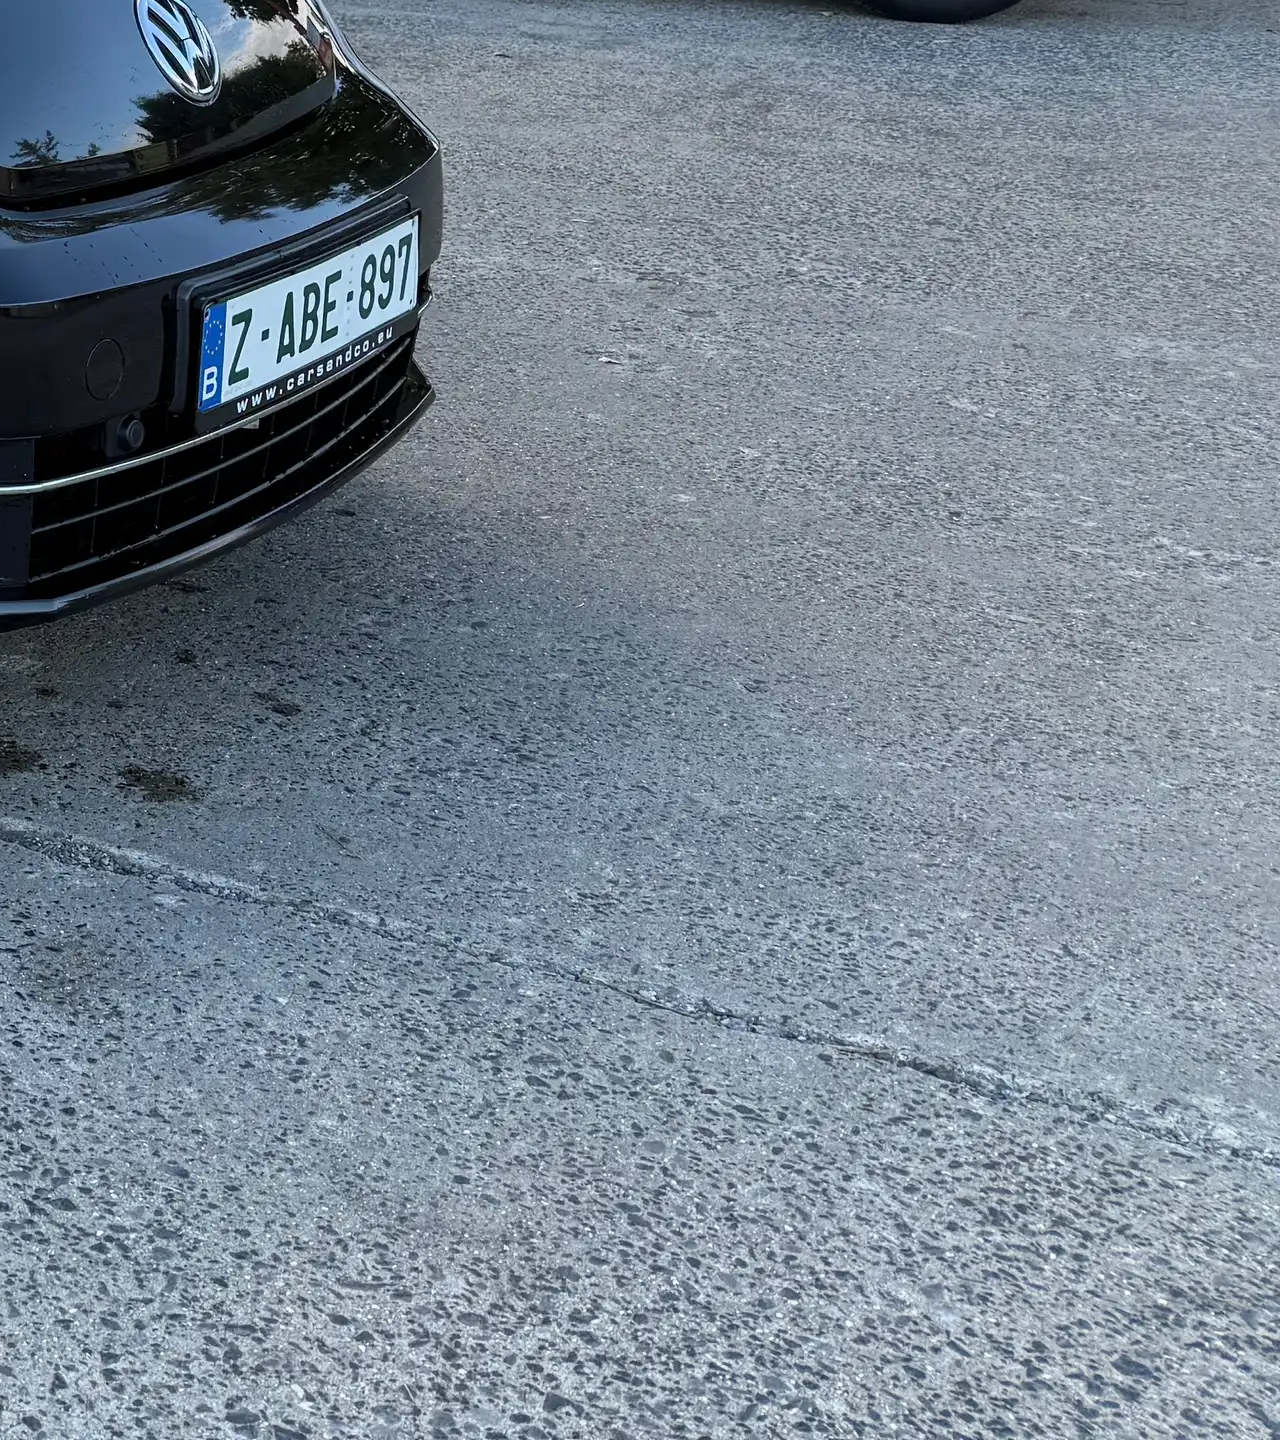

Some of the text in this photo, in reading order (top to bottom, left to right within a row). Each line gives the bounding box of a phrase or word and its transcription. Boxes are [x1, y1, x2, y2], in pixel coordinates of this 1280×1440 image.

[227, 232, 413, 387] Z-ABE-897
[202, 365, 218, 400] B
[236, 326, 393, 414] www.carsandco.eu
